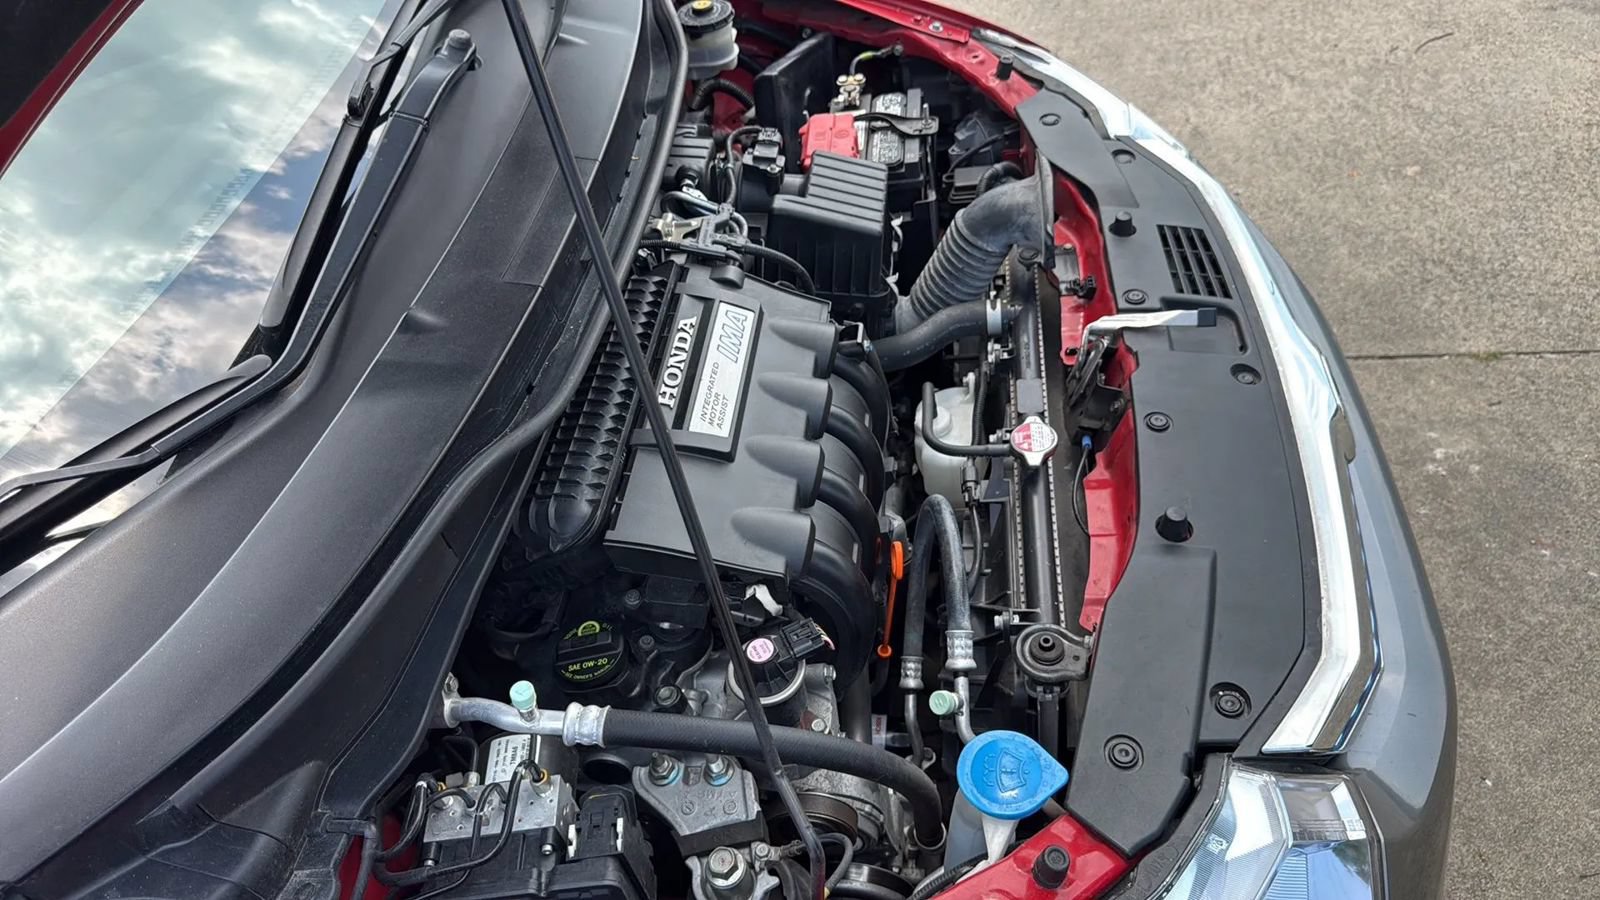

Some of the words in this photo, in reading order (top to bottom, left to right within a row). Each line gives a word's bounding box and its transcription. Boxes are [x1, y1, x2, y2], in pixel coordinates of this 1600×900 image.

[716, 309, 748, 364] IMA
[658, 316, 697, 409] HONDA
[699, 361, 720, 422] INTEGRATED
[707, 392, 721, 427] MOTOR
[716, 394, 729, 431] ASSIST
[568, 663, 581, 672] SAE
[582, 657, 608, 669] 0W-20
